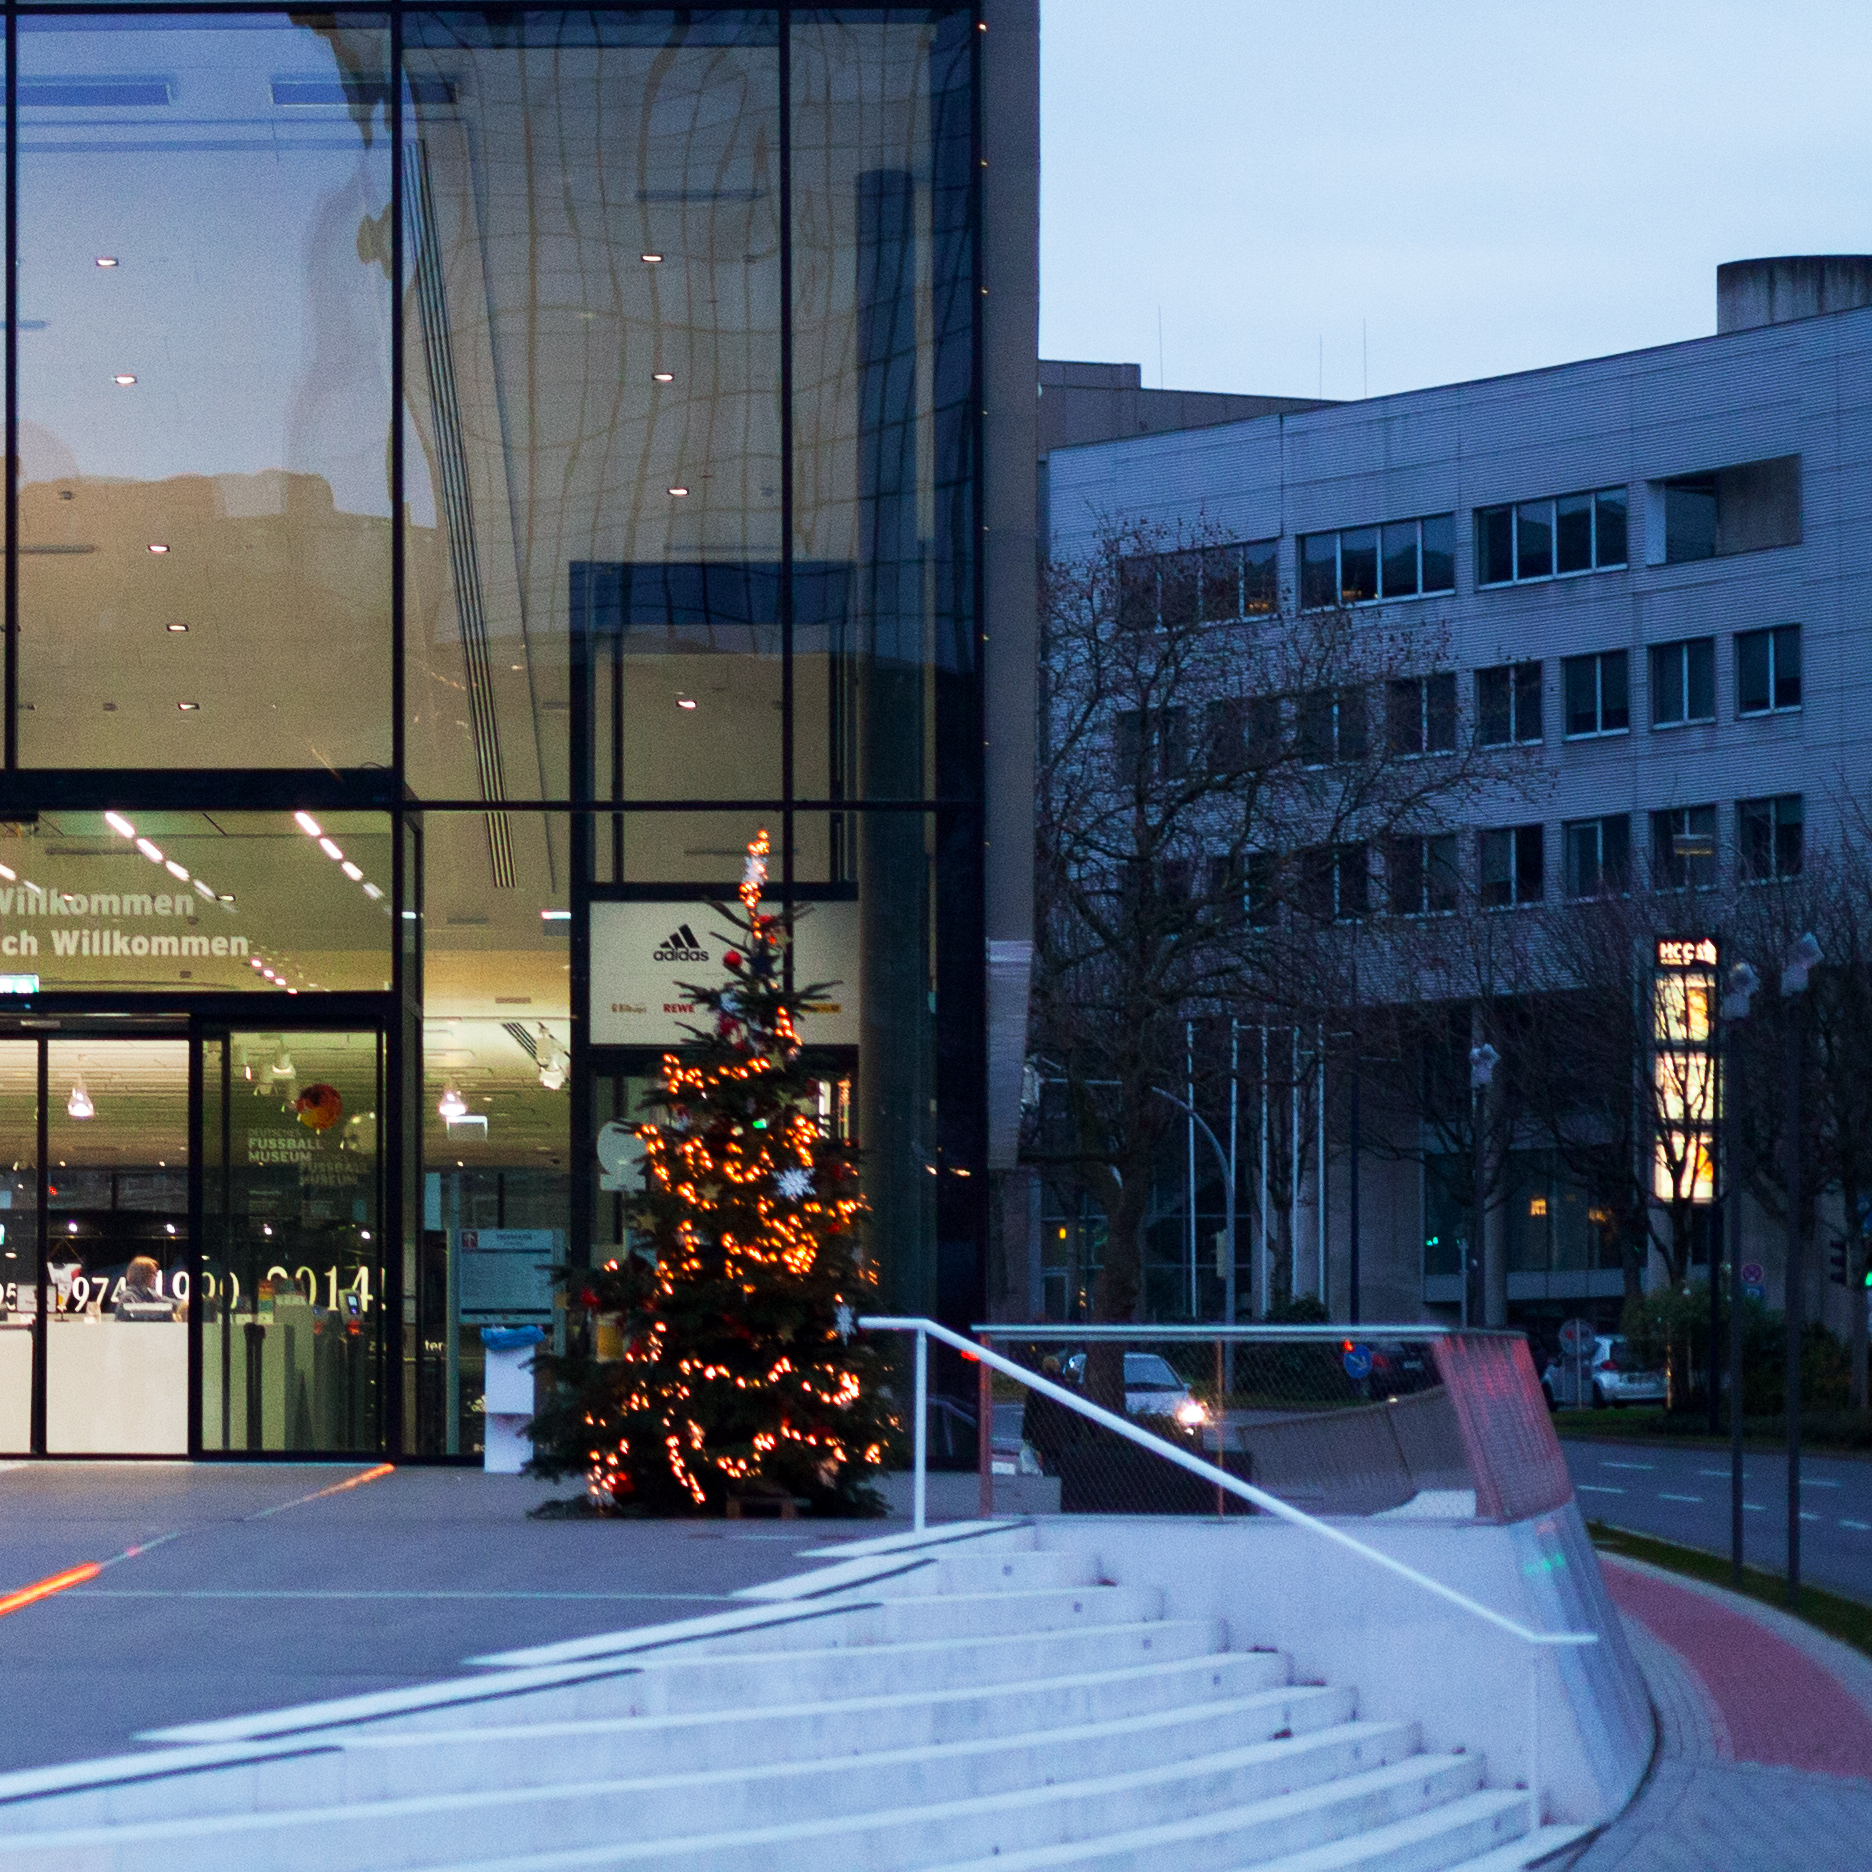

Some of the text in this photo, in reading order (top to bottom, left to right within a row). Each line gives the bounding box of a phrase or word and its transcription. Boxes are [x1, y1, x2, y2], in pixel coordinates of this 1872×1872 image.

[50, 928, 249, 957] Willkommen
[652, 947, 709, 962] adidas
[663, 1003, 695, 1014] REWE
[248, 1137, 325, 1150] FUSSBALL
[248, 1151, 313, 1163] MUSEUM
